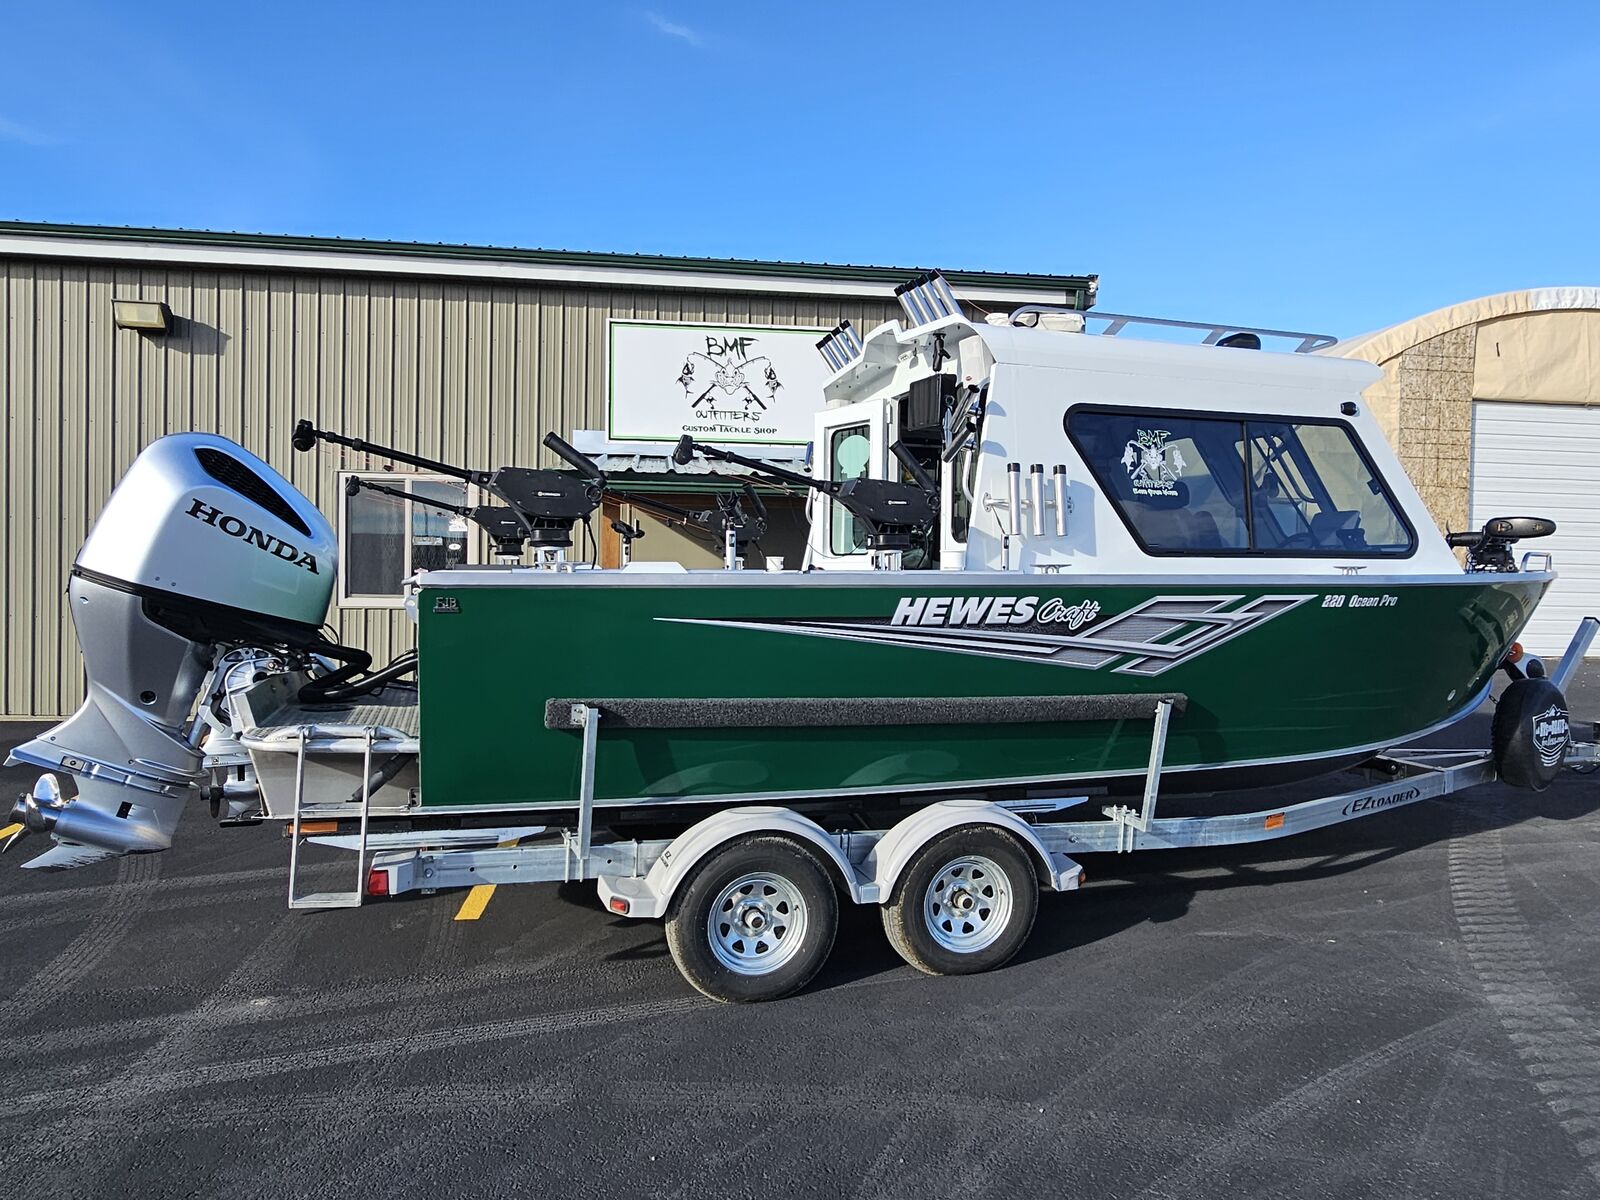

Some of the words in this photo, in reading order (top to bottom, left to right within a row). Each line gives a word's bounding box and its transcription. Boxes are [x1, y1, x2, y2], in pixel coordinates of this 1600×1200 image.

[705, 335, 758, 362] BMF
[695, 410, 762, 422] OUTFITTERS
[1137, 429, 1171, 448] BMF
[185, 498, 319, 575] HONDA
[1321, 595, 1346, 607] 220
[1348, 594, 1380, 607] Ocean
[1379, 594, 1398, 606] Pro
[891, 596, 1039, 625] HEWES
[1036, 598, 1101, 630] Craft
